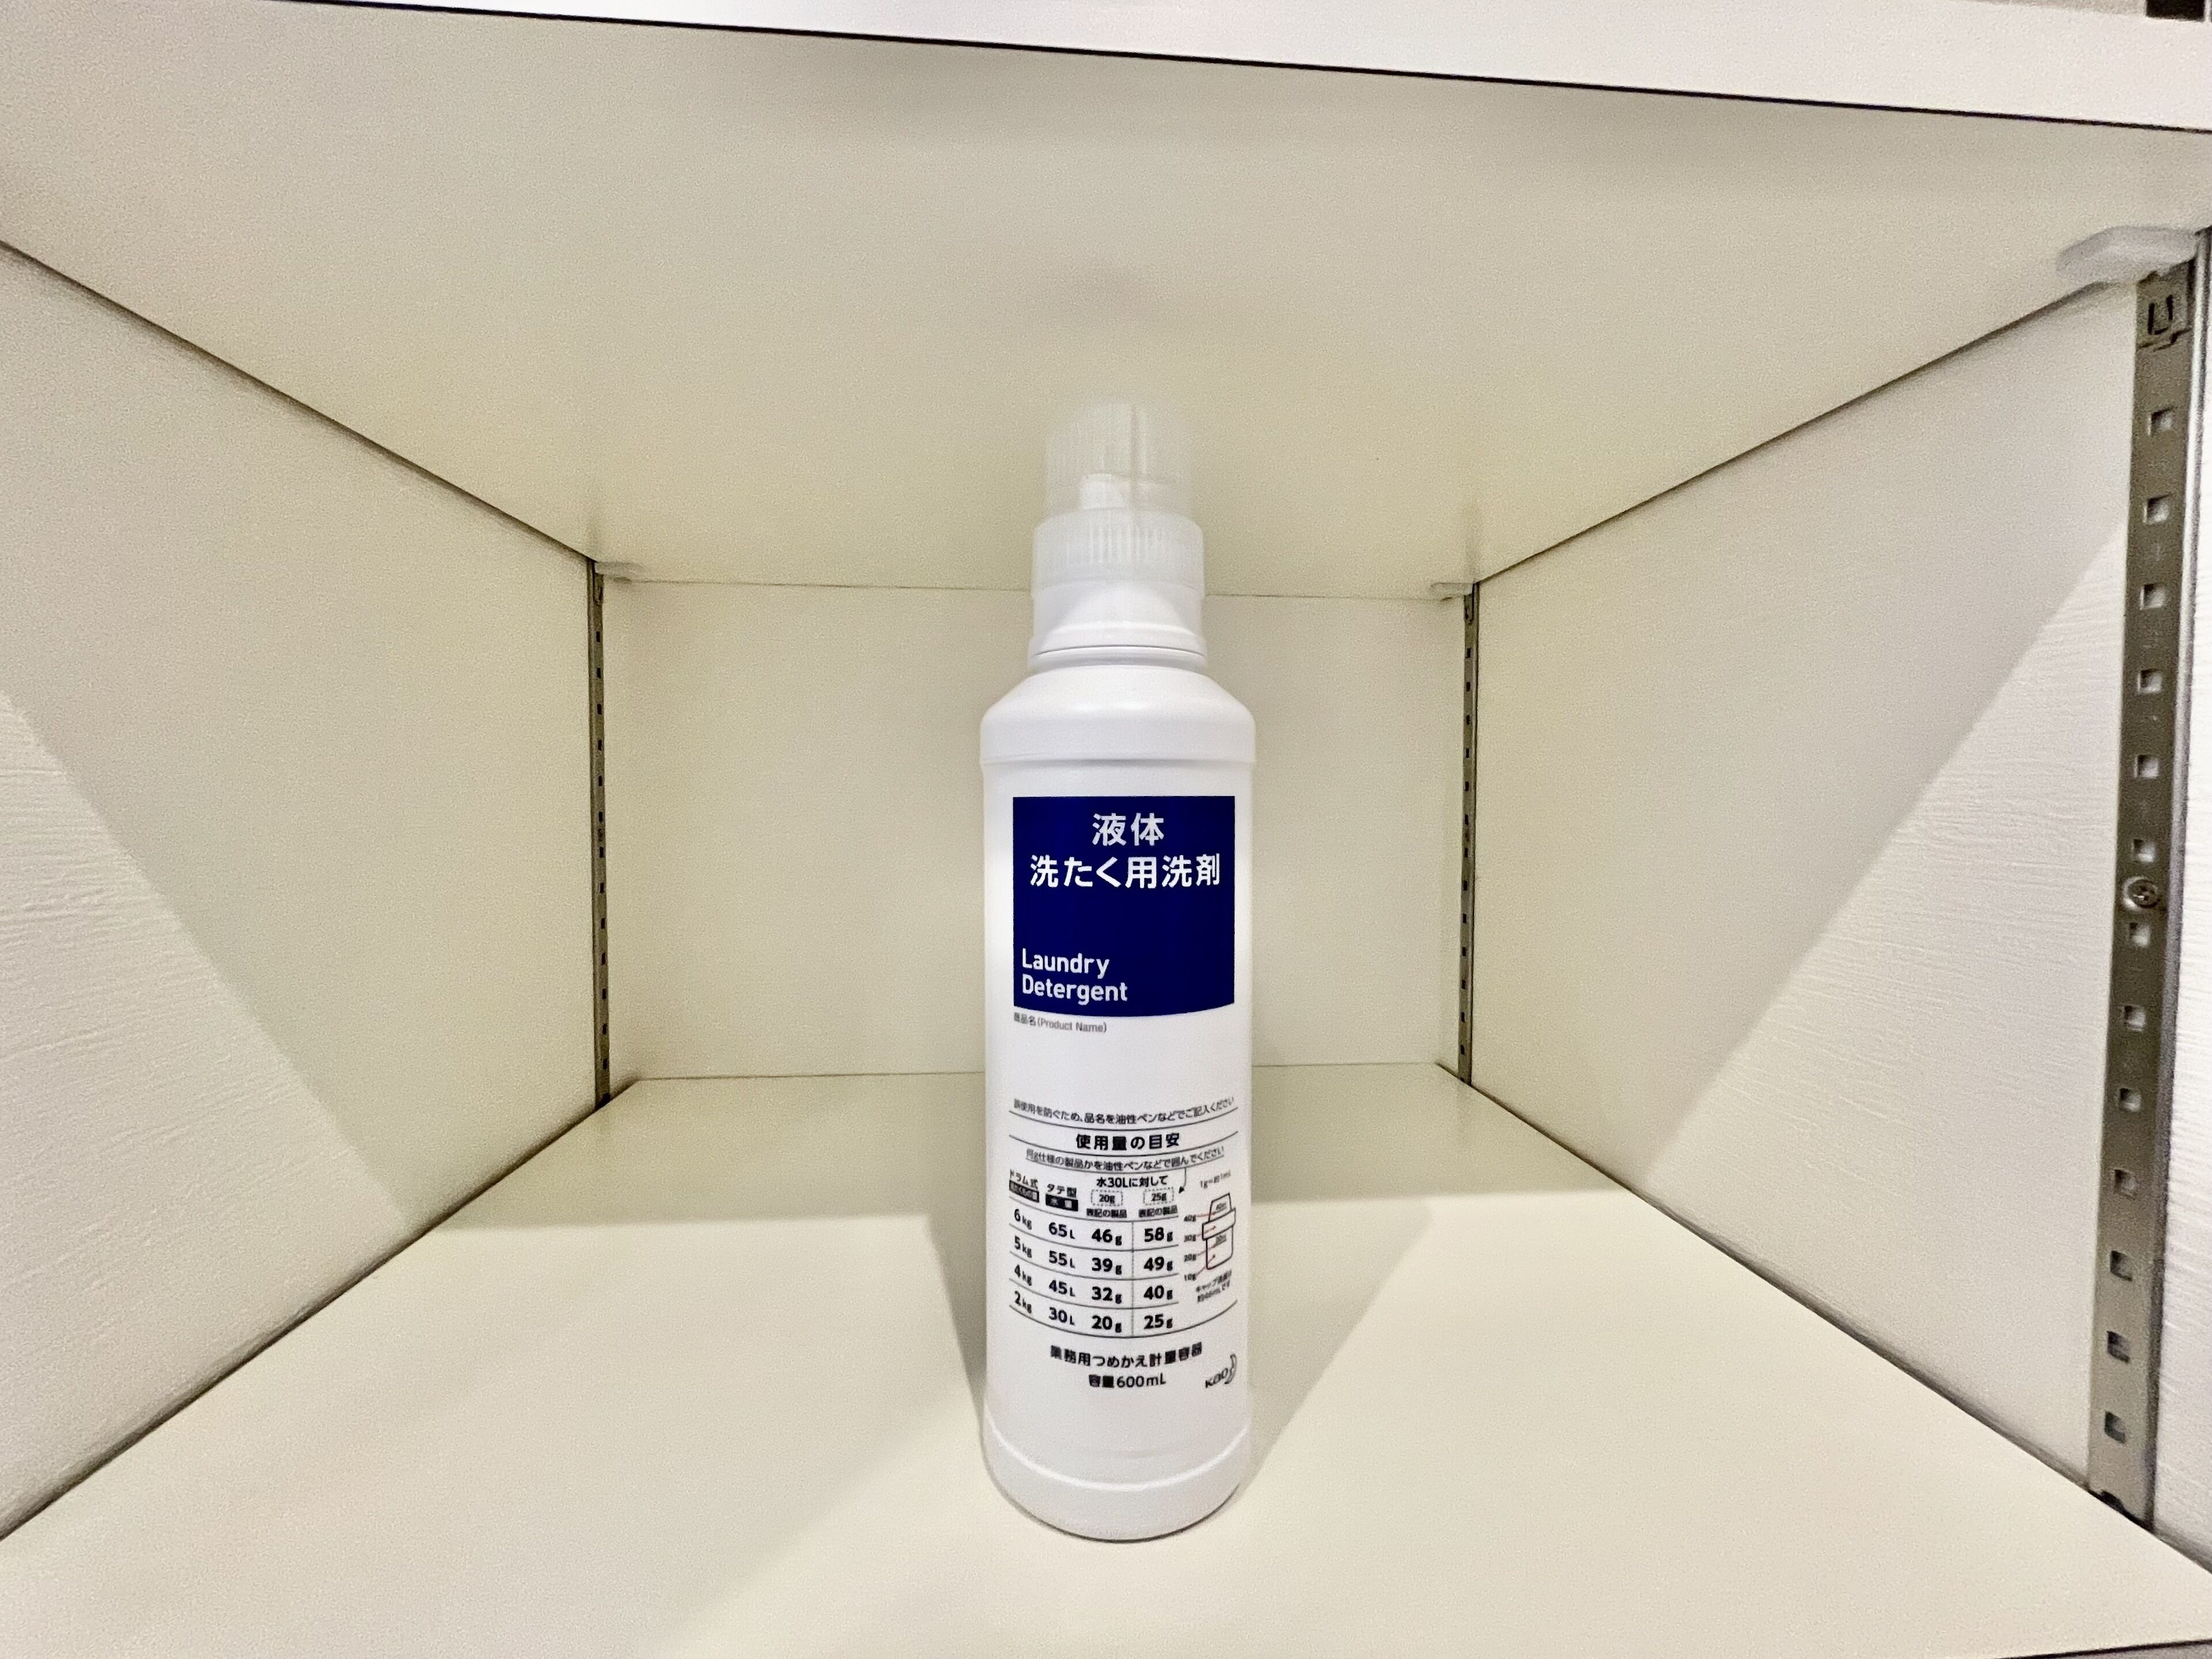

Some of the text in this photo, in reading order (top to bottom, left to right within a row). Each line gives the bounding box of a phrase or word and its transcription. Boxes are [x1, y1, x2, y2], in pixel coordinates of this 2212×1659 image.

[1092, 813, 1164, 846] 液体
[1030, 854, 1220, 888] 洗たく用洗剤
[1022, 948, 1109, 979] Laundry
[1022, 974, 1127, 1005] Detergent
[1097, 1175, 1168, 1188] 水30Lに対して
[1152, 1192, 1166, 1202] 25g
[1099, 1194, 1115, 1203] 20g
